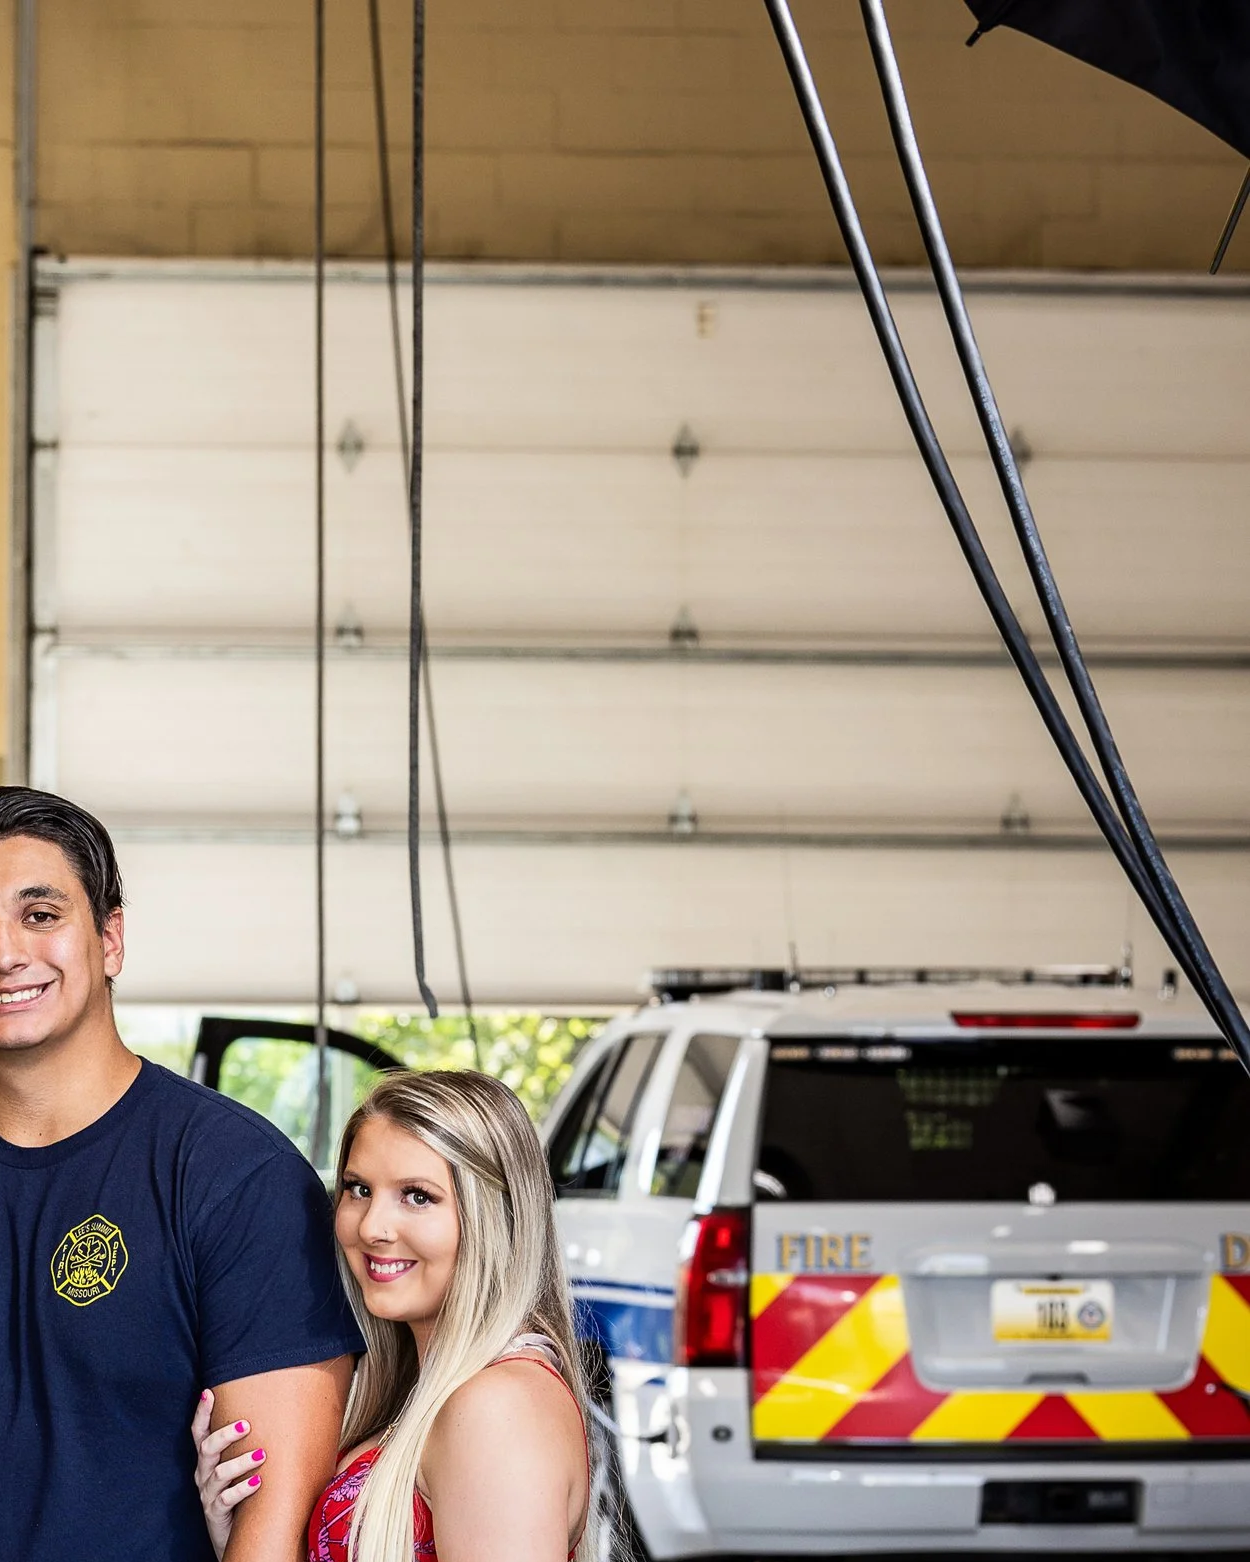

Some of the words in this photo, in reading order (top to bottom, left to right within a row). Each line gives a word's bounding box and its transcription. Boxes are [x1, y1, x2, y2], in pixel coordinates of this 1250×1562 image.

[74, 1224, 90, 1238] LEE'S
[91, 1222, 113, 1236] SUMMIT
[57, 1244, 69, 1279] FIRE
[111, 1241, 119, 1277] DEPT
[776, 1232, 874, 1272] FIRE
[66, 1286, 101, 1298] MISSOURI
